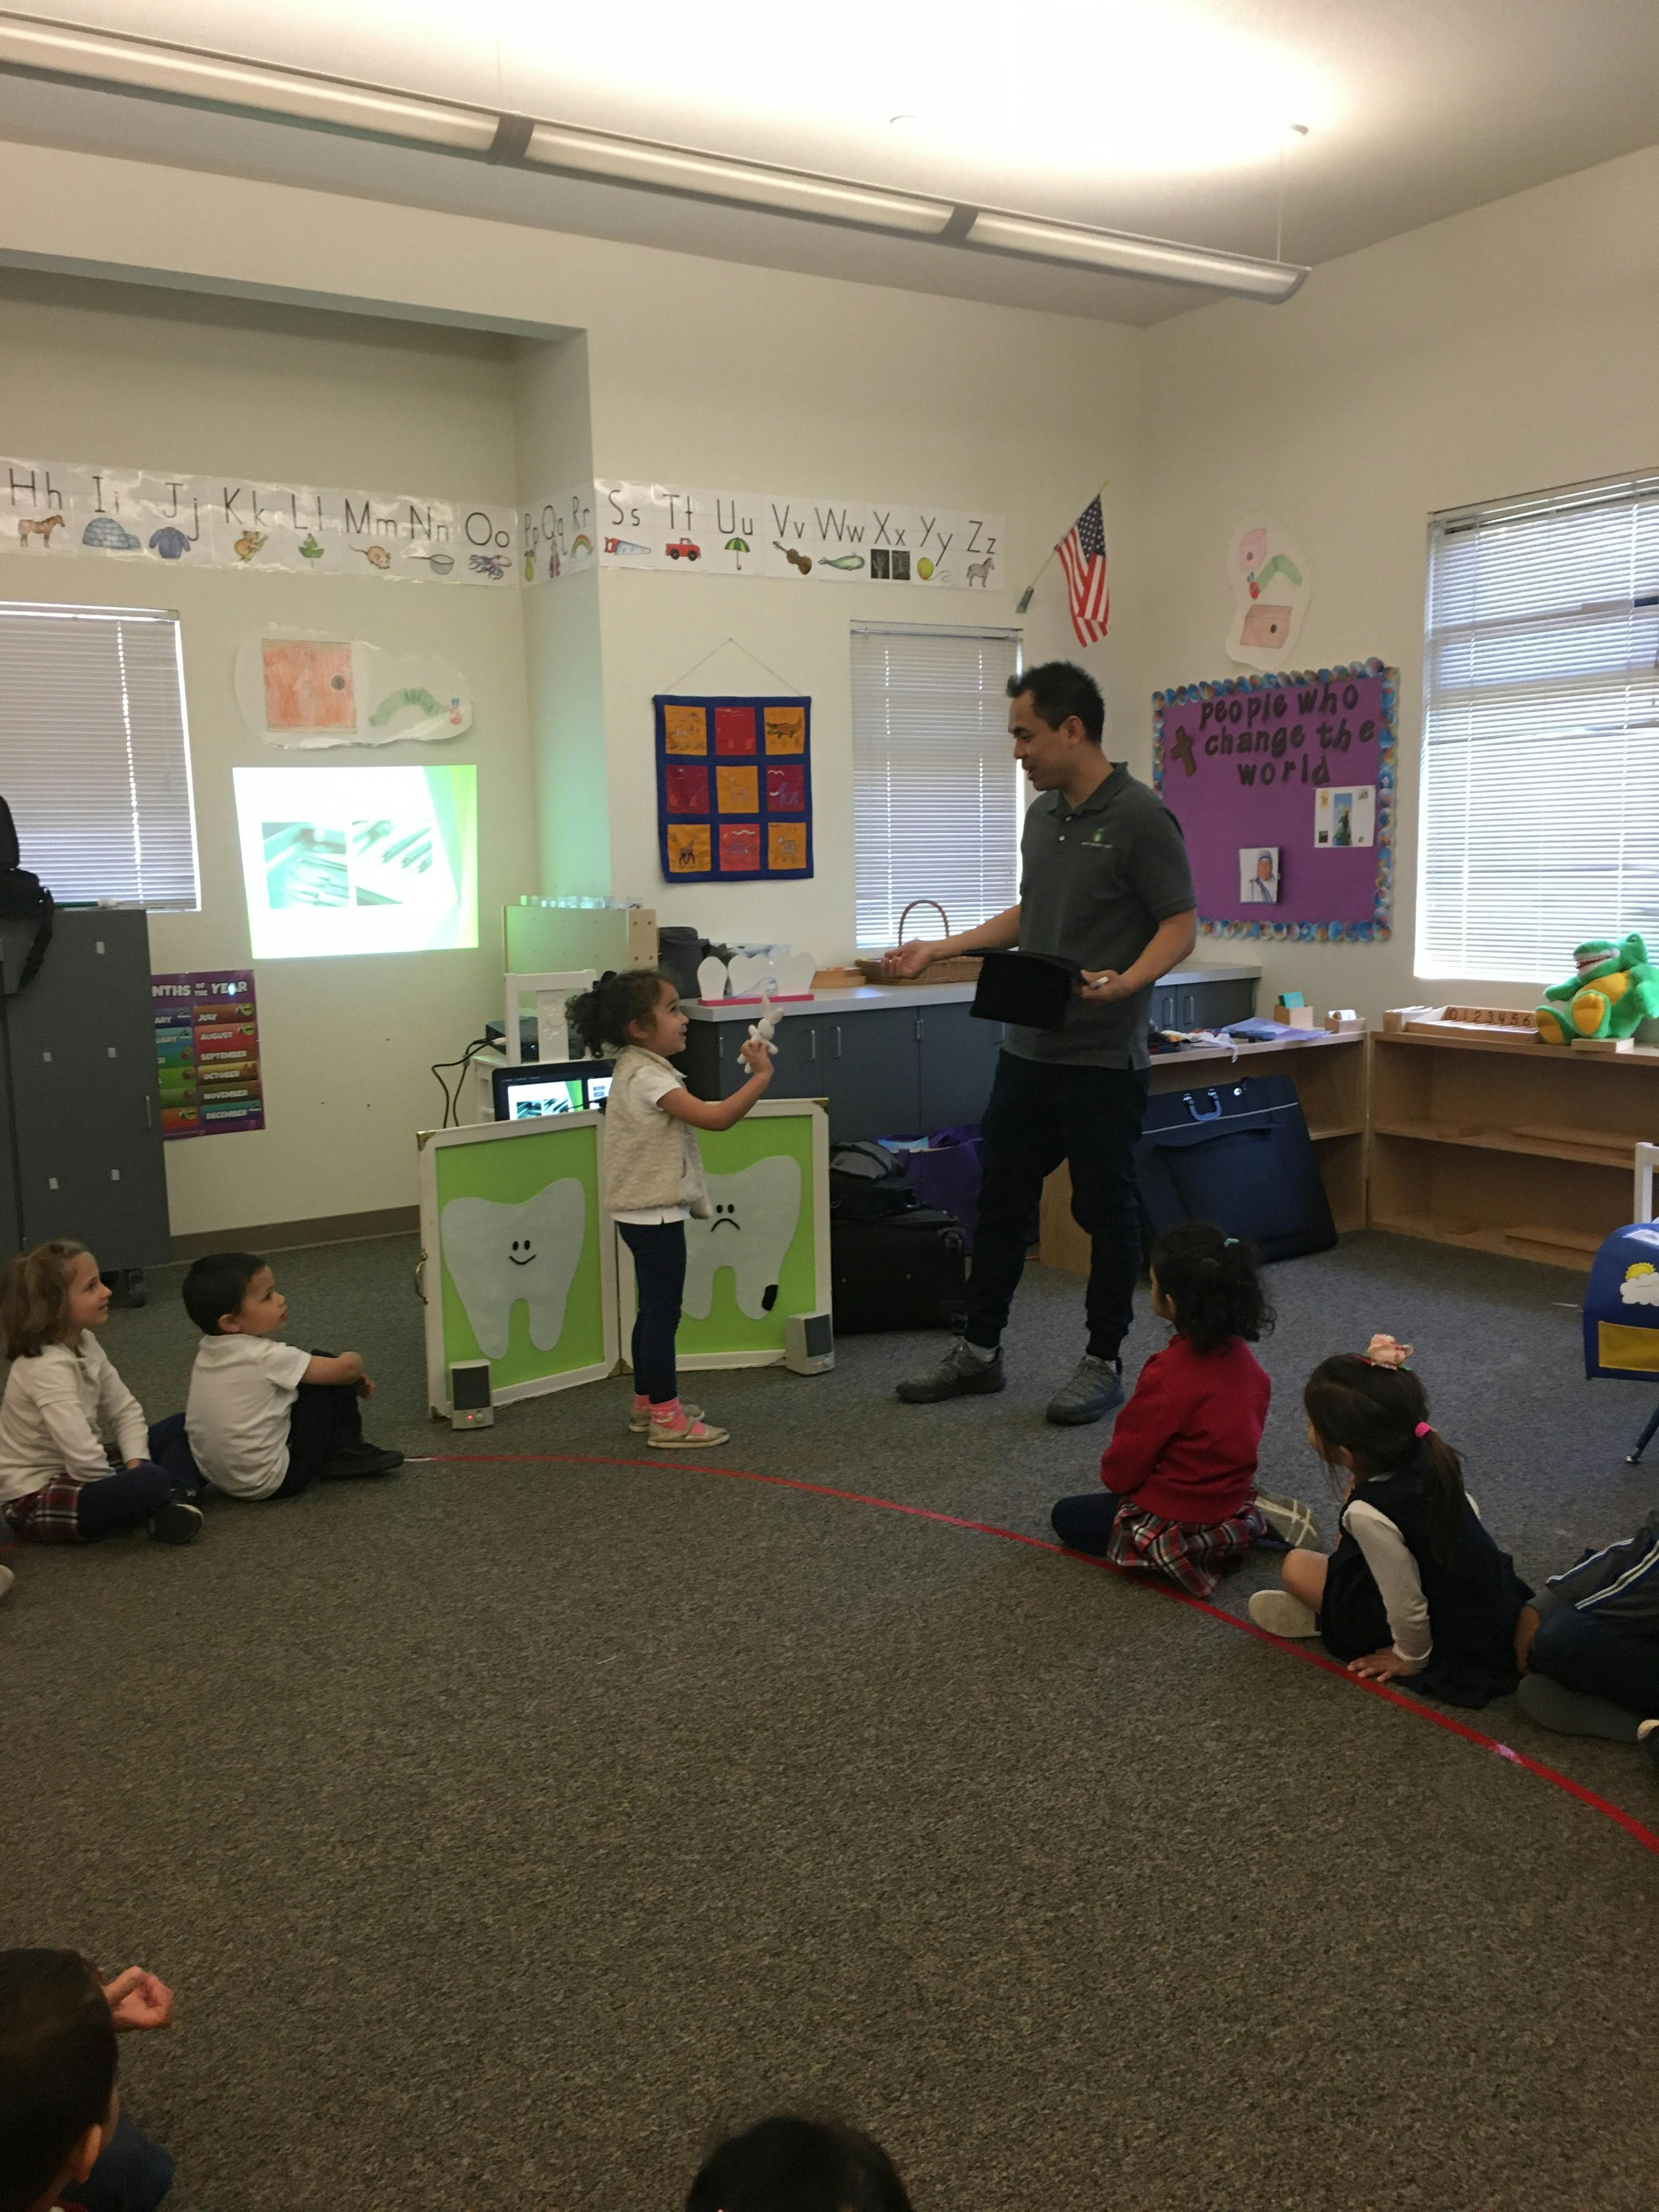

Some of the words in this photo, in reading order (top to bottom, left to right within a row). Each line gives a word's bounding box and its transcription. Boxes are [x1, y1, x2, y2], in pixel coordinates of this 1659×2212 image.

[9, 467, 63, 510] Hh
[92, 476, 120, 515] Ii
[163, 482, 200, 541] Jj
[223, 487, 268, 527] Kk
[291, 493, 323, 531] Ll
[345, 498, 398, 537] Mm
[409, 505, 449, 543] Nn
[465, 511, 510, 548] Oo
[524, 512, 539, 563] Pp
[541, 504, 568, 556] Qq
[572, 495, 590, 531] Rr
[608, 489, 641, 527] Ss
[662, 493, 693, 531] Tt
[716, 498, 754, 536] Uu
[771, 503, 805, 539] Vv
[814, 506, 865, 543] Ww
[873, 510, 906, 546] Xx
[920, 515, 953, 567] Yy
[967, 520, 996, 554] Zz
[1199, 692, 1288, 731] people
[1297, 682, 1359, 716] who
[1204, 723, 1306, 758] change
[1315, 718, 1375, 752] the
[1236, 751, 1330, 786] world
[151, 984, 191, 997] NTHS
[198, 1013, 218, 1022] JULY
[1473, 1010, 1481, 1023] 2
[1487, 1011, 1494, 1024] 3
[1498, 1013, 1506, 1024] 4
[1510, 1013, 1519, 1025] 5
[1522, 1014, 1531, 1026] 6
[200, 1031, 233, 1041] AUGUST
[200, 1050, 247, 1061] SEPTEMBER
[203, 1070, 240, 1080] OCTOBER
[203, 1089, 248, 1100] NOVEMBER
[206, 1109, 247, 1120] DECEMBER
